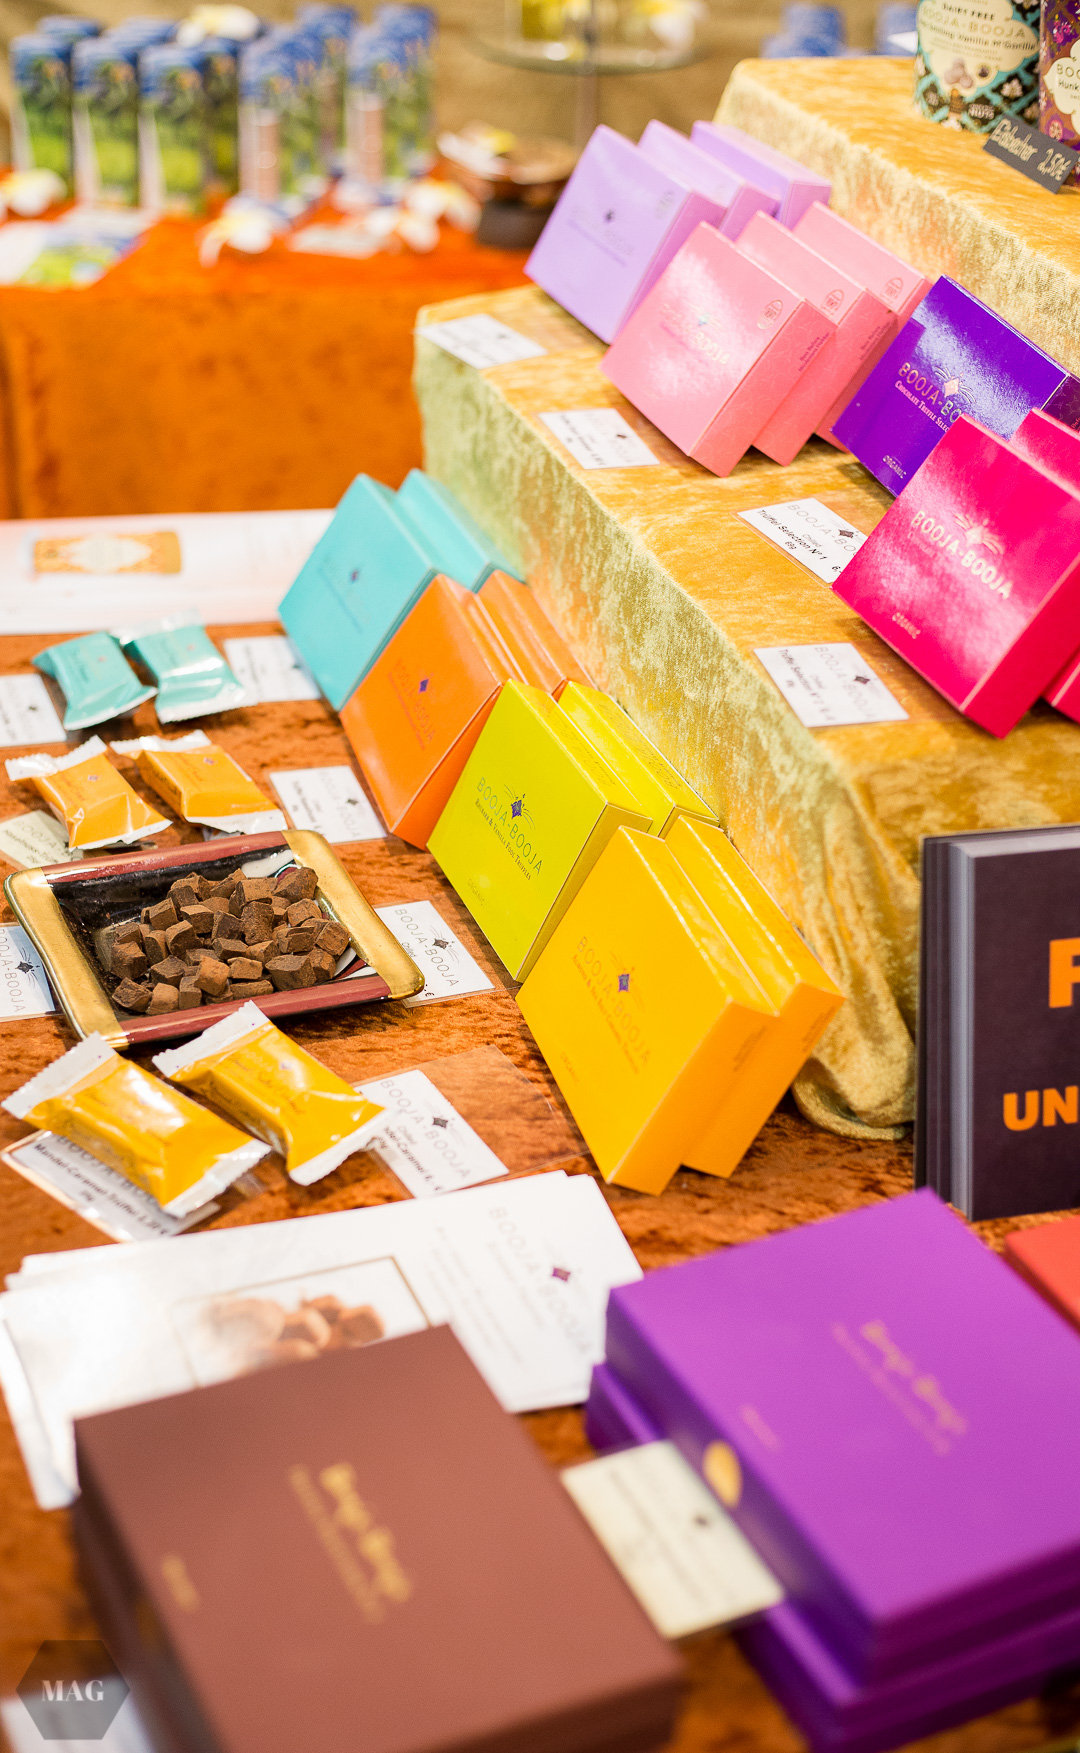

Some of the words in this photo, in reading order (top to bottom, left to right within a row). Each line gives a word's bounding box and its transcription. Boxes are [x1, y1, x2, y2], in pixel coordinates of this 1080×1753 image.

[971, 10, 996, 21] FREE
[898, 362, 962, 423] BOOJA-BO
[778, 525, 811, 550] Selection
[911, 511, 1014, 600] BOOJA-BOOJA
[477, 777, 543, 875] BOOJA-BOOJA
[395, 908, 459, 986] BOOJA-BOOJA
[577, 936, 651, 1067] BOOJA-BOOJA
[378, 1079, 475, 1178] BOOJA-BOOJA
[1003, 1086, 1078, 1131] UN
